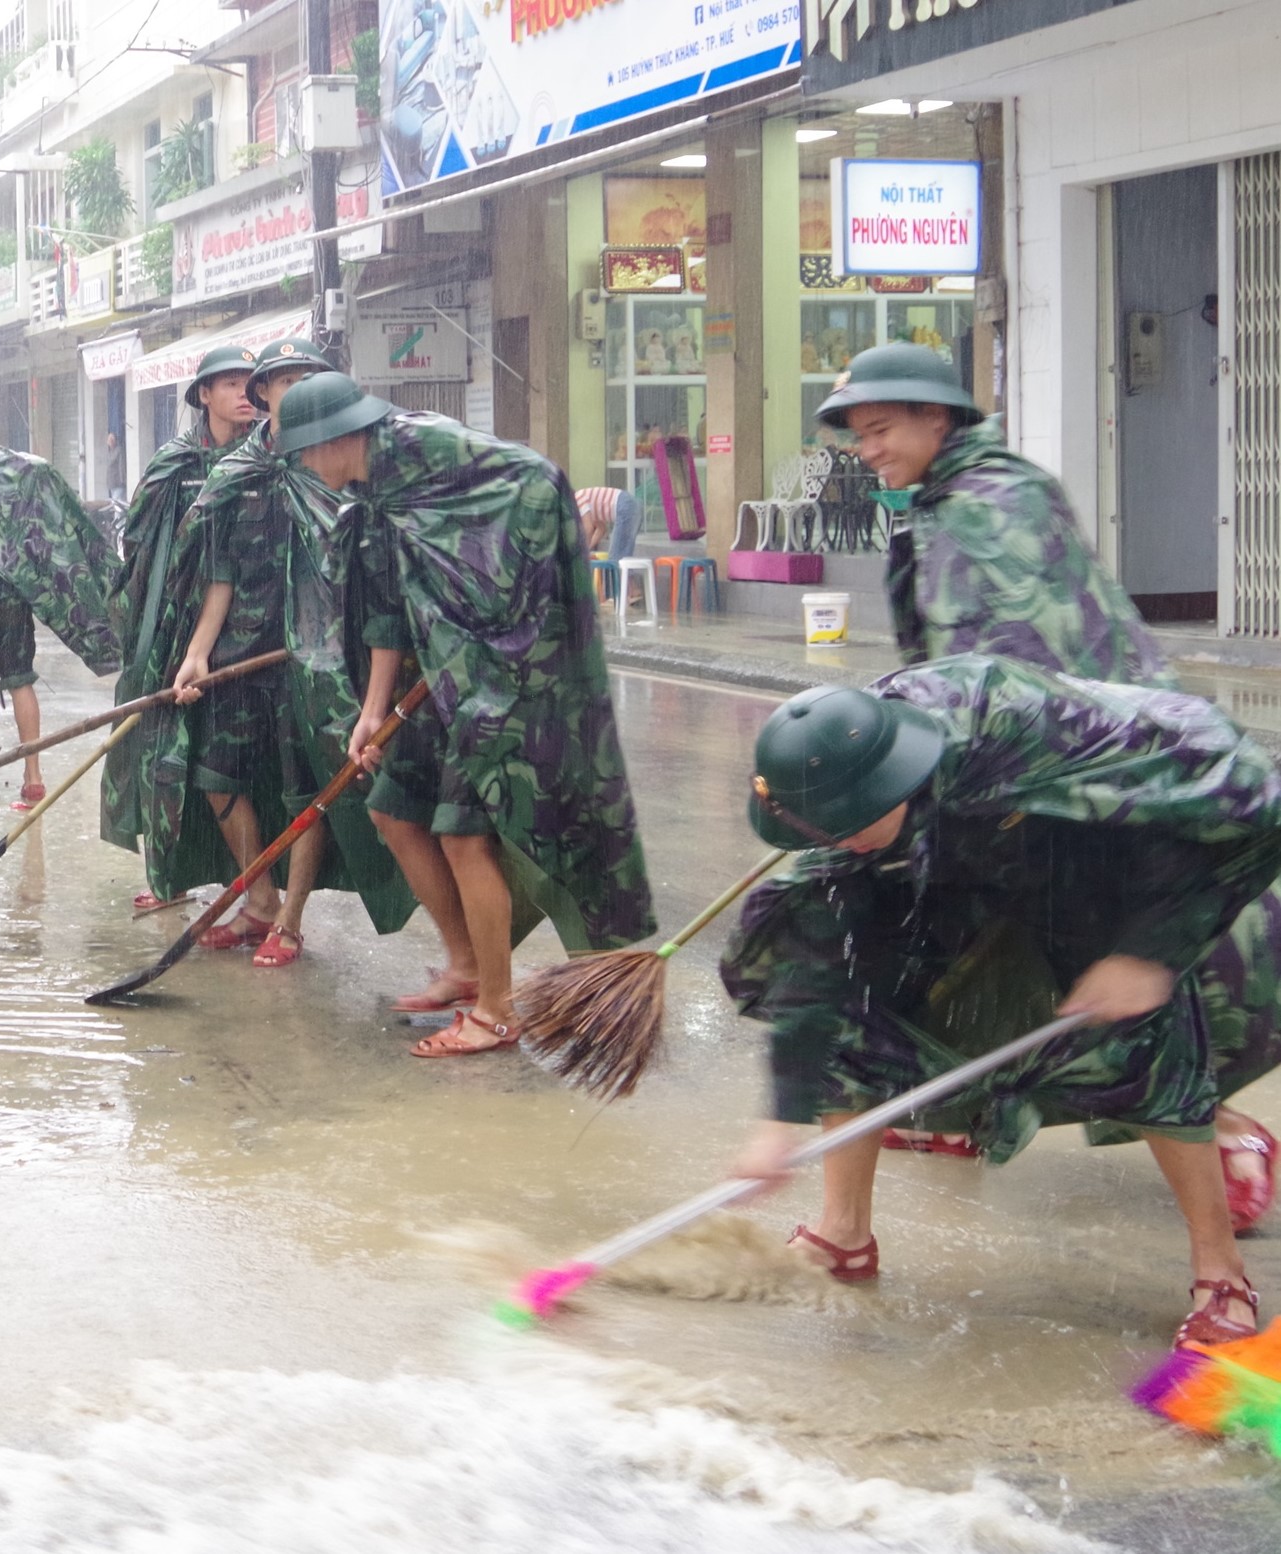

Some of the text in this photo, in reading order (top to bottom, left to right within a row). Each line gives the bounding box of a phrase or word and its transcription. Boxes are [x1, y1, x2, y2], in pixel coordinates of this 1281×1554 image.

[757, 14, 779, 33] 0984
[618, 66, 630, 82] 105
[719, 21, 734, 46] HUẾ
[881, 180, 944, 206] NỘI THẤT
[852, 211, 969, 245] PHƯƠNG NGUYÊN
[435, 290, 454, 305] 103
